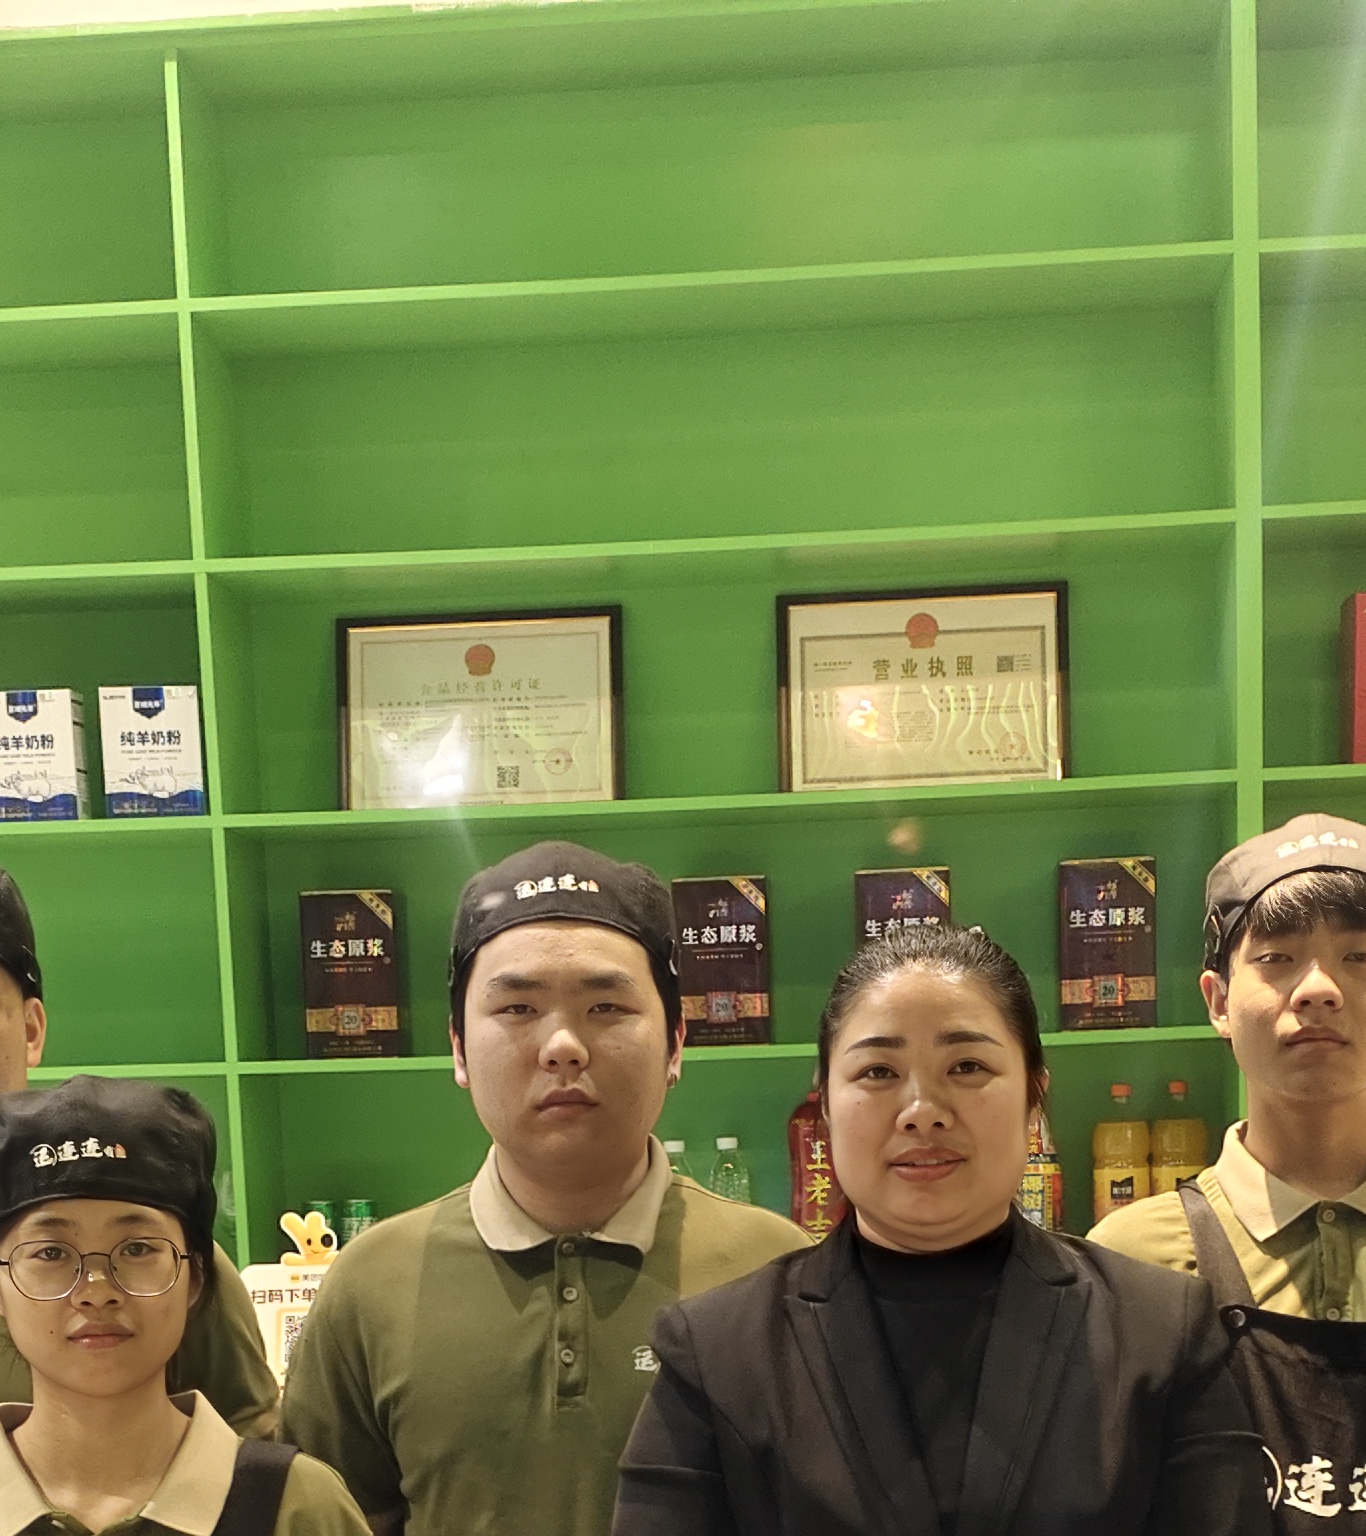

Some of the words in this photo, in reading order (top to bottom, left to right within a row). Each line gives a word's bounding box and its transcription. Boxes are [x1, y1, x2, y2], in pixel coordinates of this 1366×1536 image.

[872, 655, 974, 681] 营业执照
[120, 730, 181, 746] 纯羊奶粉
[1069, 906, 1146, 928] 生态原浆
[681, 924, 757, 945] 生态原浆
[310, 938, 385, 958] 生态原浆
[251, 1288, 318, 1305] 扫码下单
